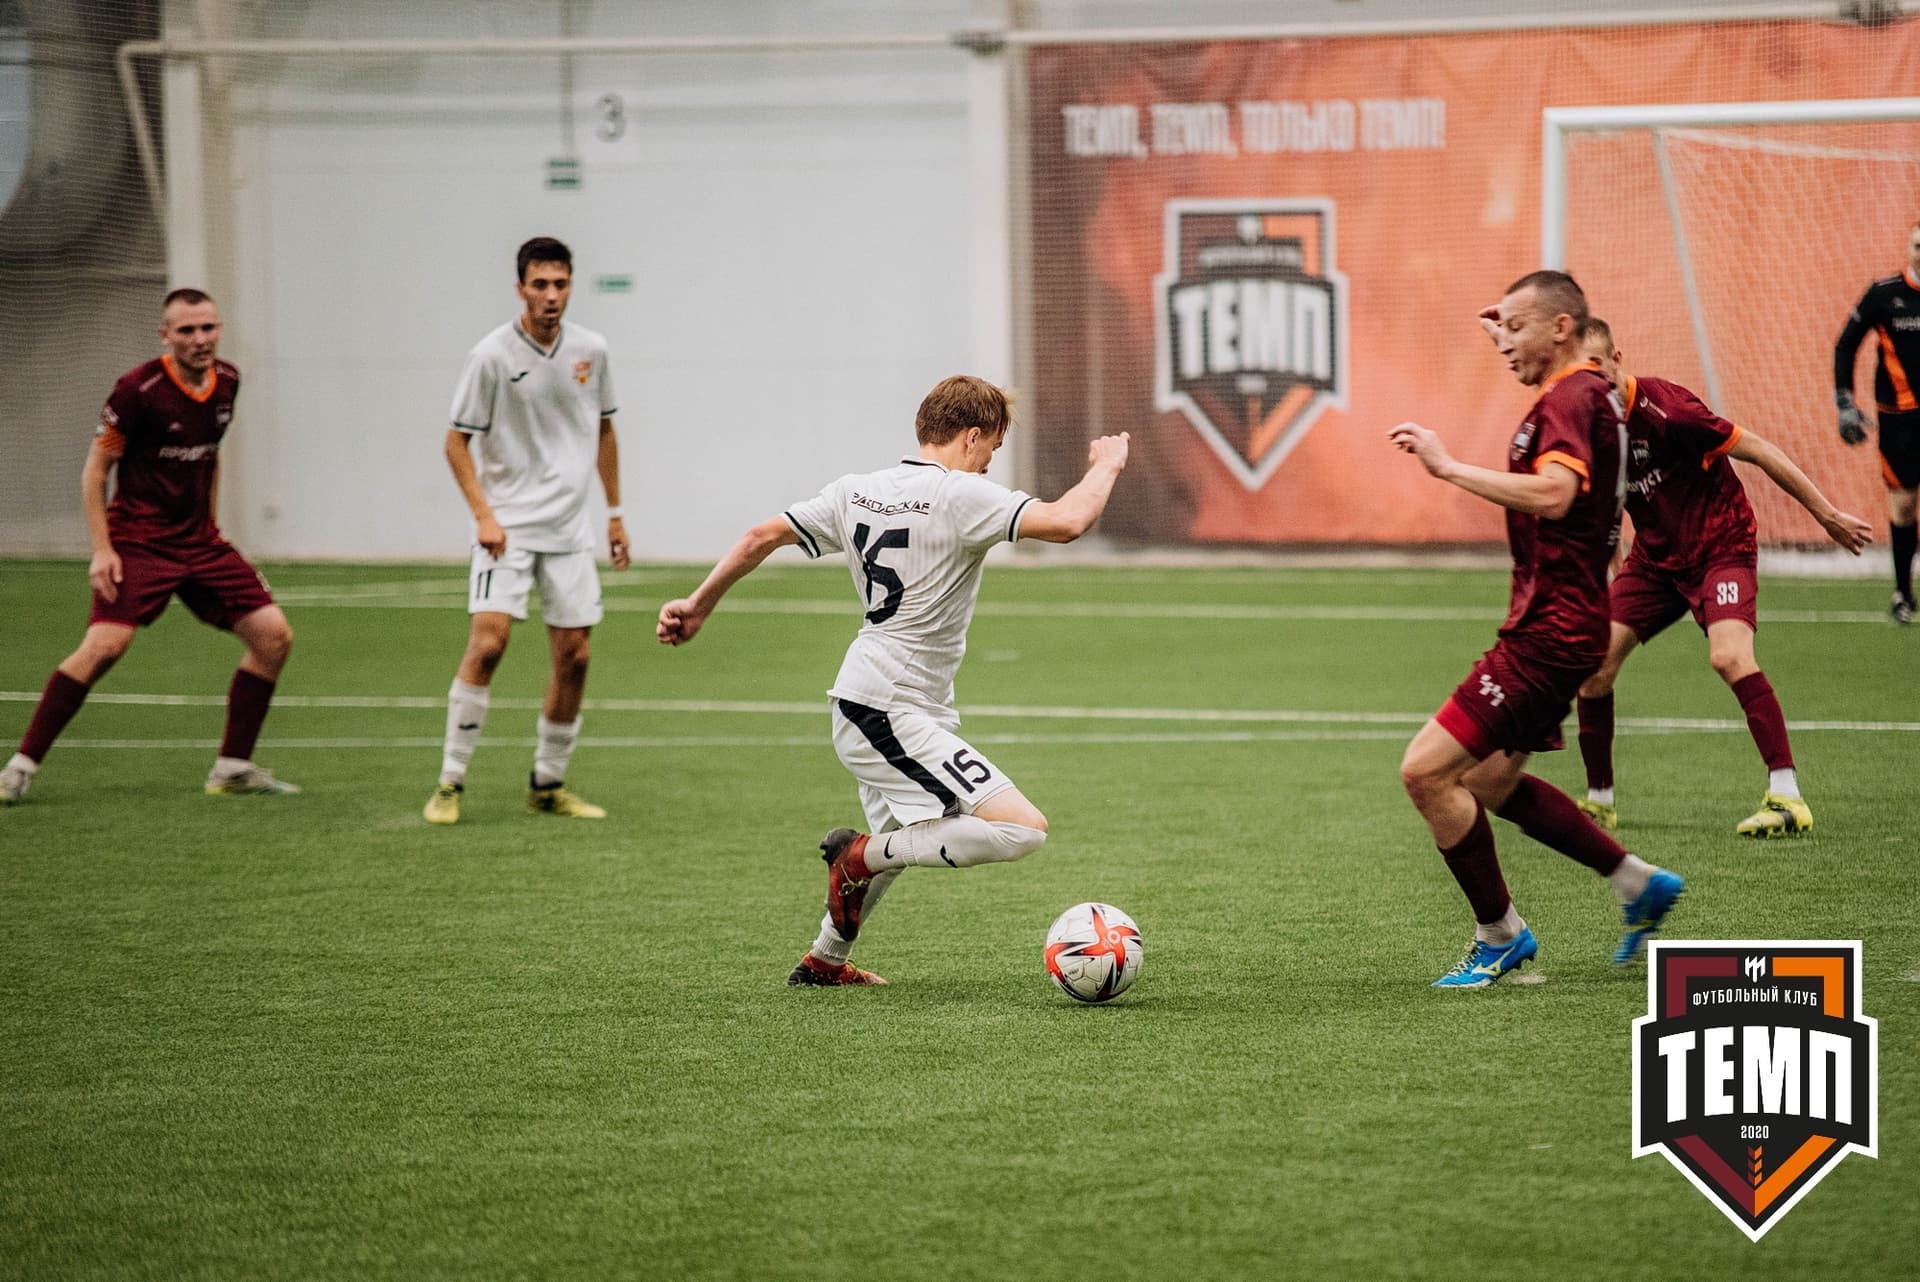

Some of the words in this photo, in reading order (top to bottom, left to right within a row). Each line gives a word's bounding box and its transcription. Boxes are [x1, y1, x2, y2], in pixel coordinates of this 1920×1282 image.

[597, 93, 626, 143] 3
[1172, 278, 1331, 379] ТЕМП
[942, 748, 991, 794] 15
